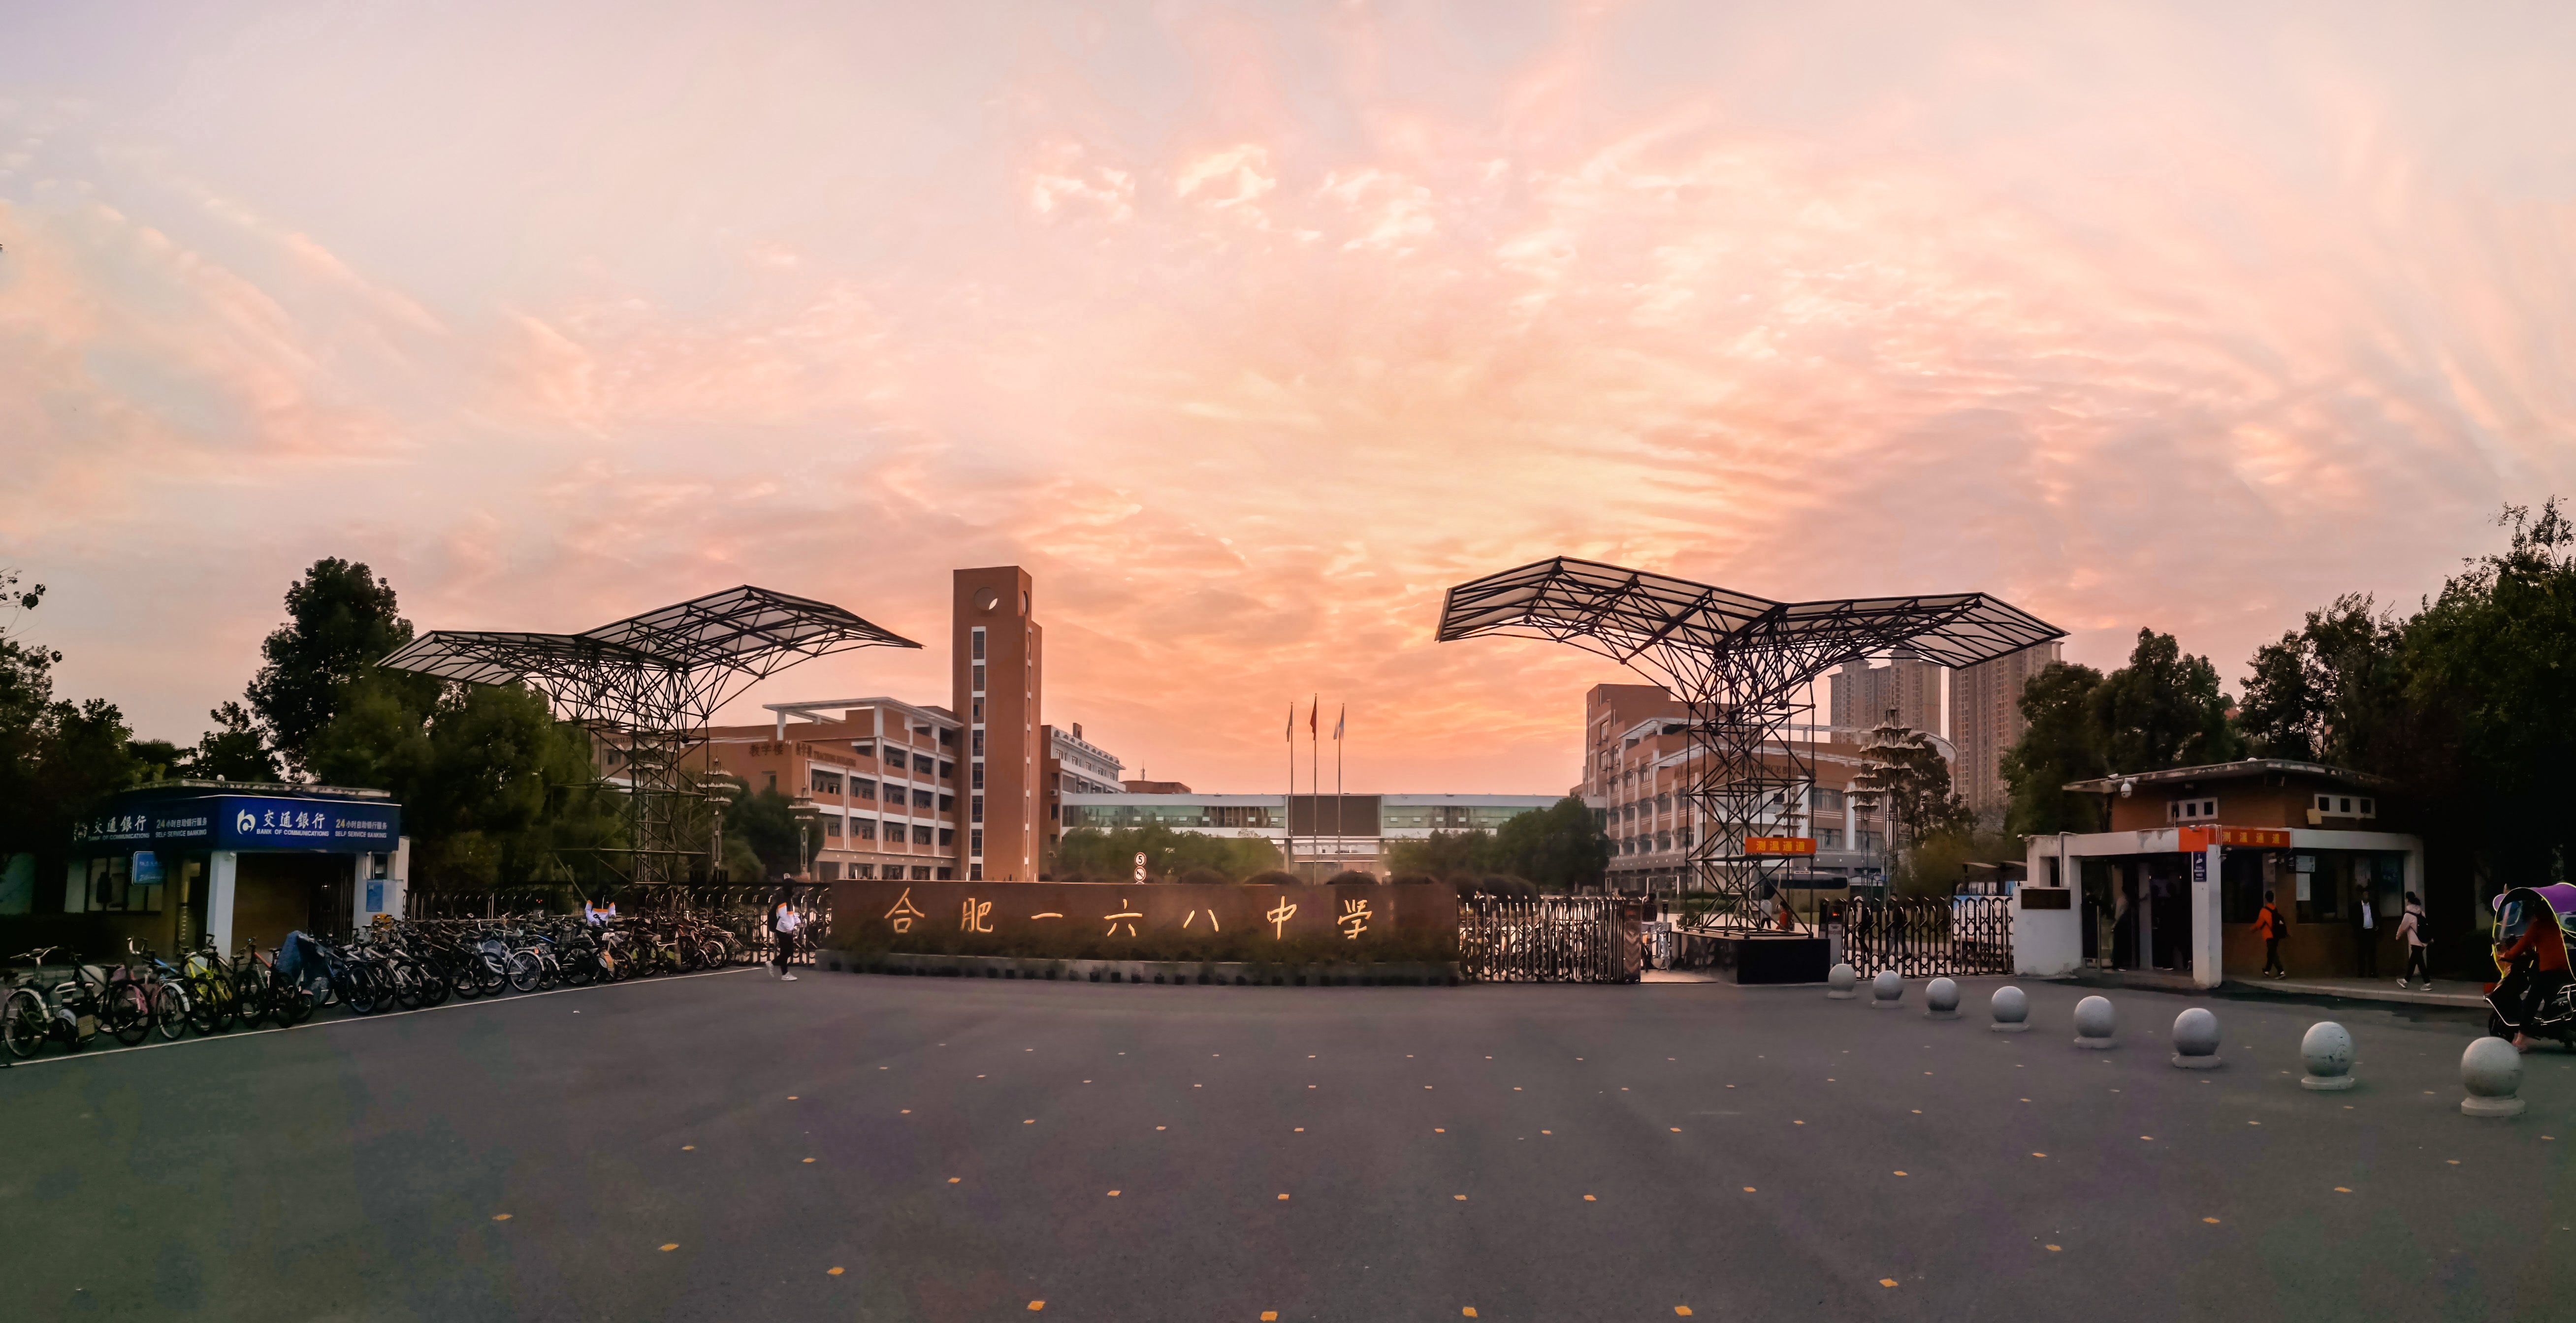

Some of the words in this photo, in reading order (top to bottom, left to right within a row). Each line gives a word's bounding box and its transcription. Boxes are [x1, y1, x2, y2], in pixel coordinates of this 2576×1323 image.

[749, 743, 783, 757] 教学楼
[93, 815, 147, 834] 交通銀行
[263, 809, 325, 829] 交通銀行
[1756, 841, 1805, 851] 测温通道
[1138, 855, 1142, 864] 5
